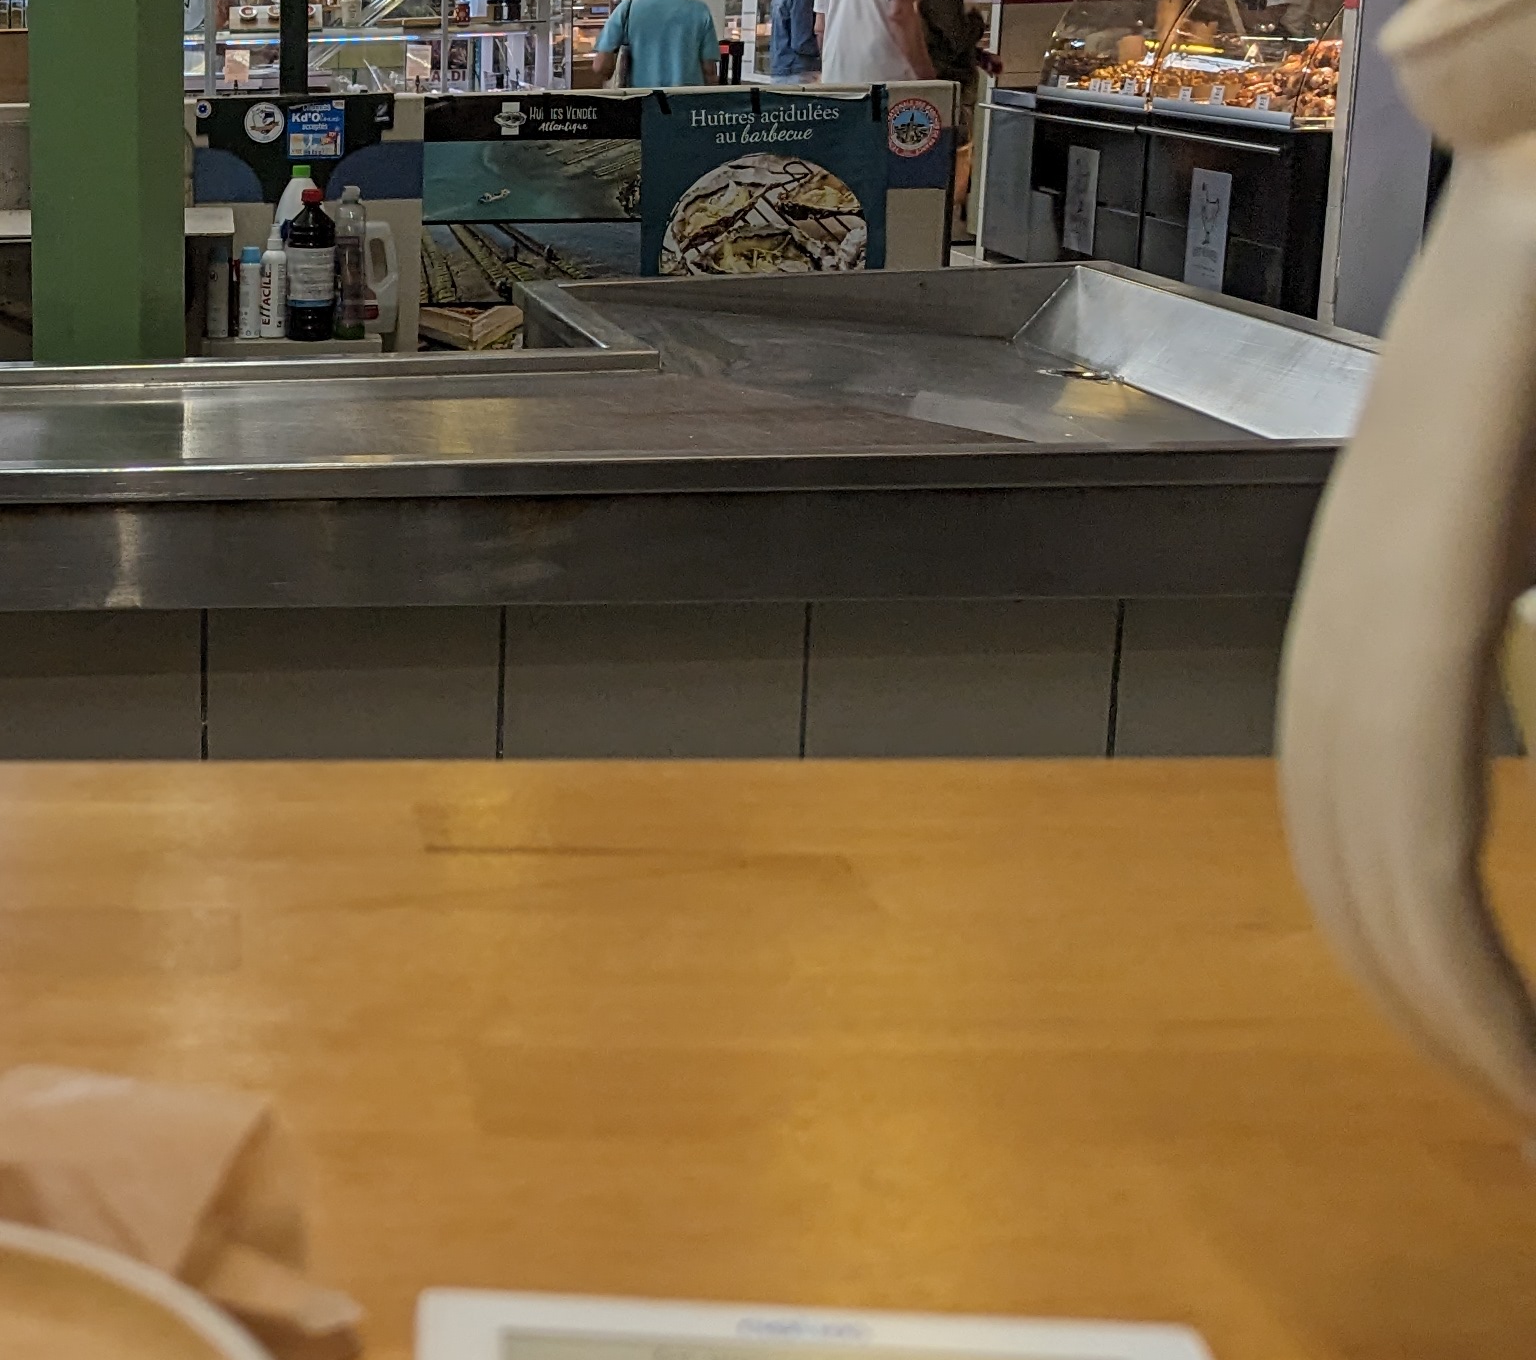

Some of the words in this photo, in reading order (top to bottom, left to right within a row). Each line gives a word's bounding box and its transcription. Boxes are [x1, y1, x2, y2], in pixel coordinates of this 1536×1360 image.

[690, 108, 755, 127] Huîtres
[760, 104, 840, 124] acidulées
[715, 130, 737, 144] au
[740, 123, 814, 144] barbecue
